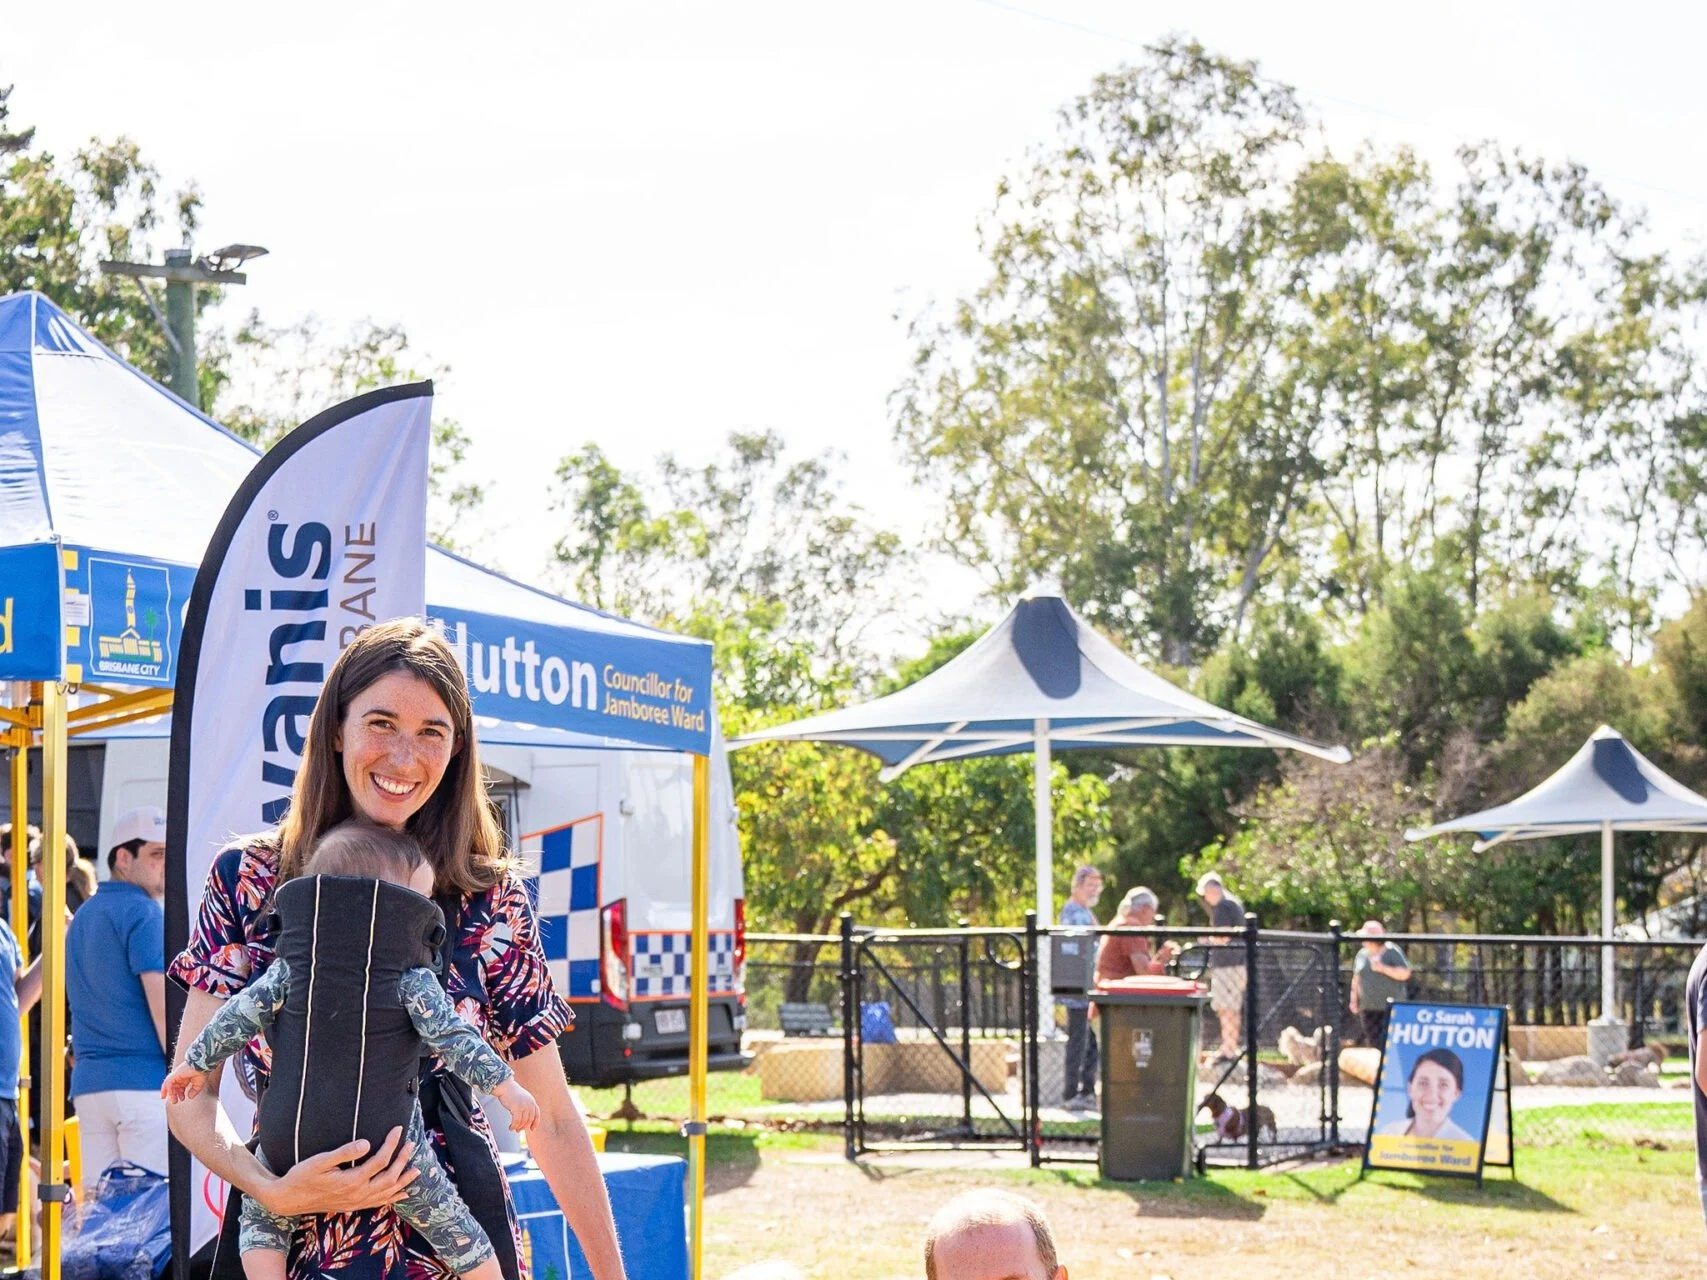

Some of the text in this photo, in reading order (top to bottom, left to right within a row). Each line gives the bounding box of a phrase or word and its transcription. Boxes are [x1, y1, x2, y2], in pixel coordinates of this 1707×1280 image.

[98, 660, 160, 676] BRISBANE CITY
[603, 664, 693, 704] Councillor for
[603, 691, 704, 732] Jamboree Ward
[1416, 1008, 1475, 1026] Cr Sarah
[1392, 1022, 1495, 1049] HUTTON
